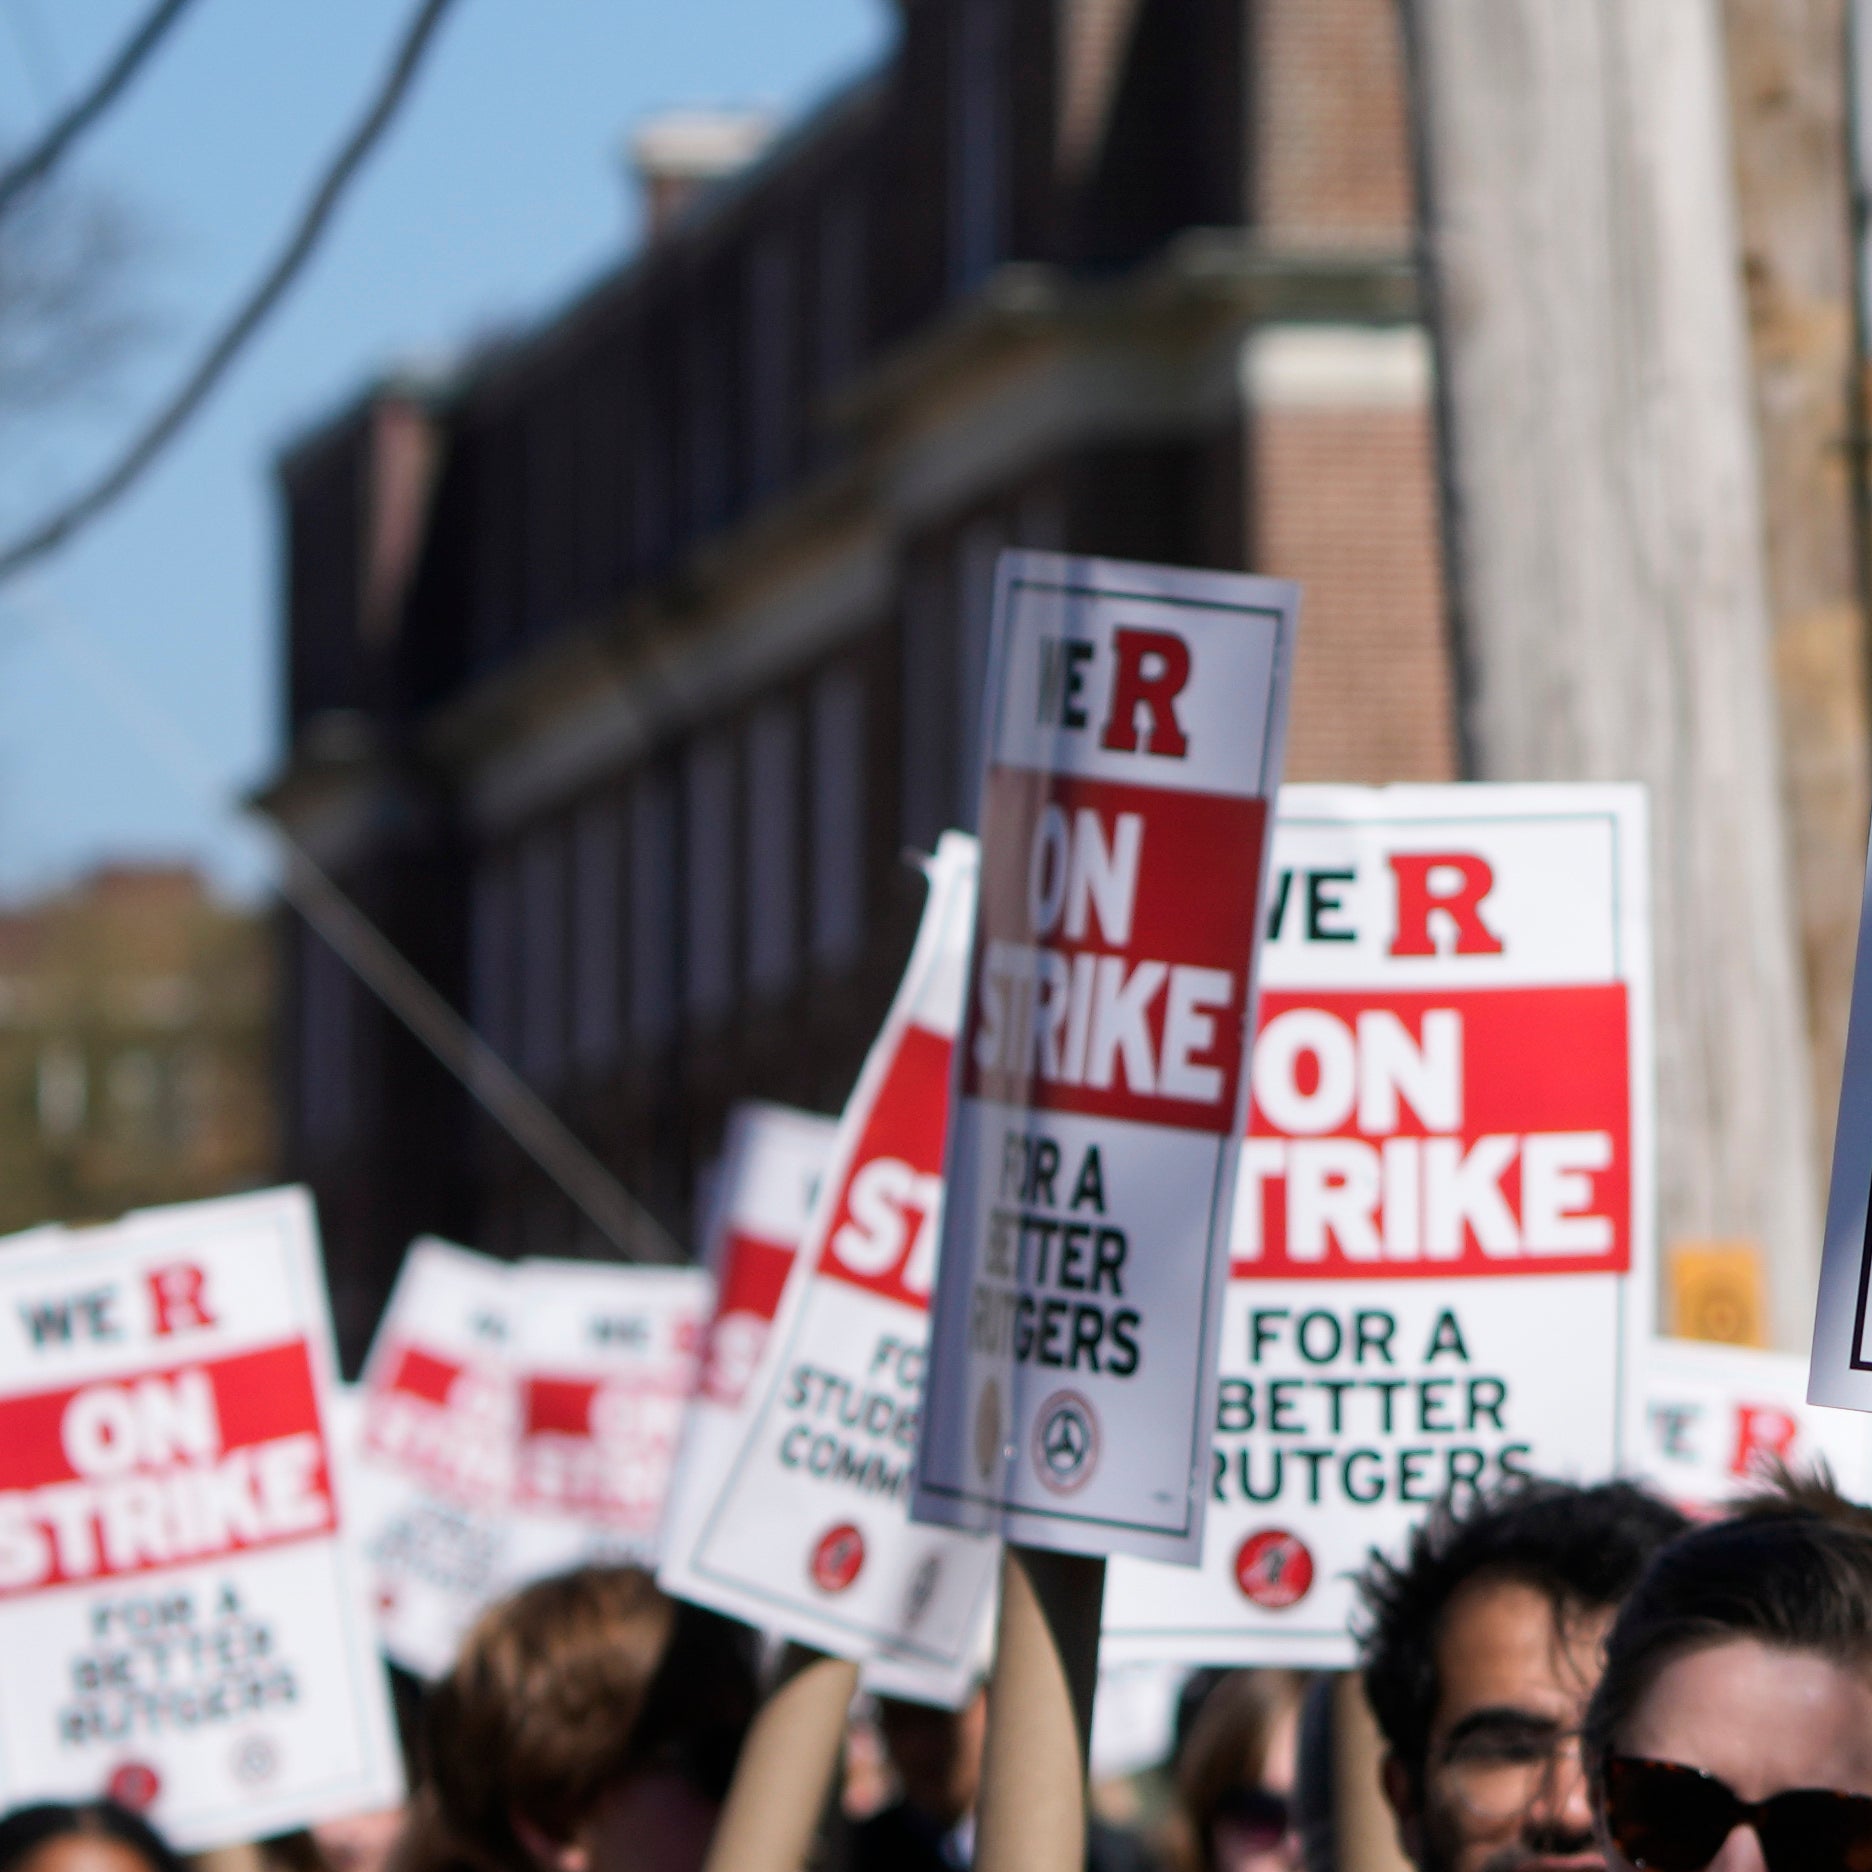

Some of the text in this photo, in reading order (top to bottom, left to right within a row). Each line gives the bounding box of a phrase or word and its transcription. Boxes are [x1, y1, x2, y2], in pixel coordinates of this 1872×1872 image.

[1102, 627, 1191, 760] R
[1386, 852, 1505, 958] R
[1252, 1006, 1463, 1136] ON
[1074, 1143, 1106, 1214] A
[1230, 1131, 1614, 1261] TRIKE
[17, 1262, 219, 1352] WE R
[1250, 1308, 1470, 1366] FOR A
[869, 1334, 928, 1391] FO
[1217, 1376, 1508, 1434] BETTER
[62, 1366, 219, 1480] ON
[0, 1432, 328, 1588] STRIKE
